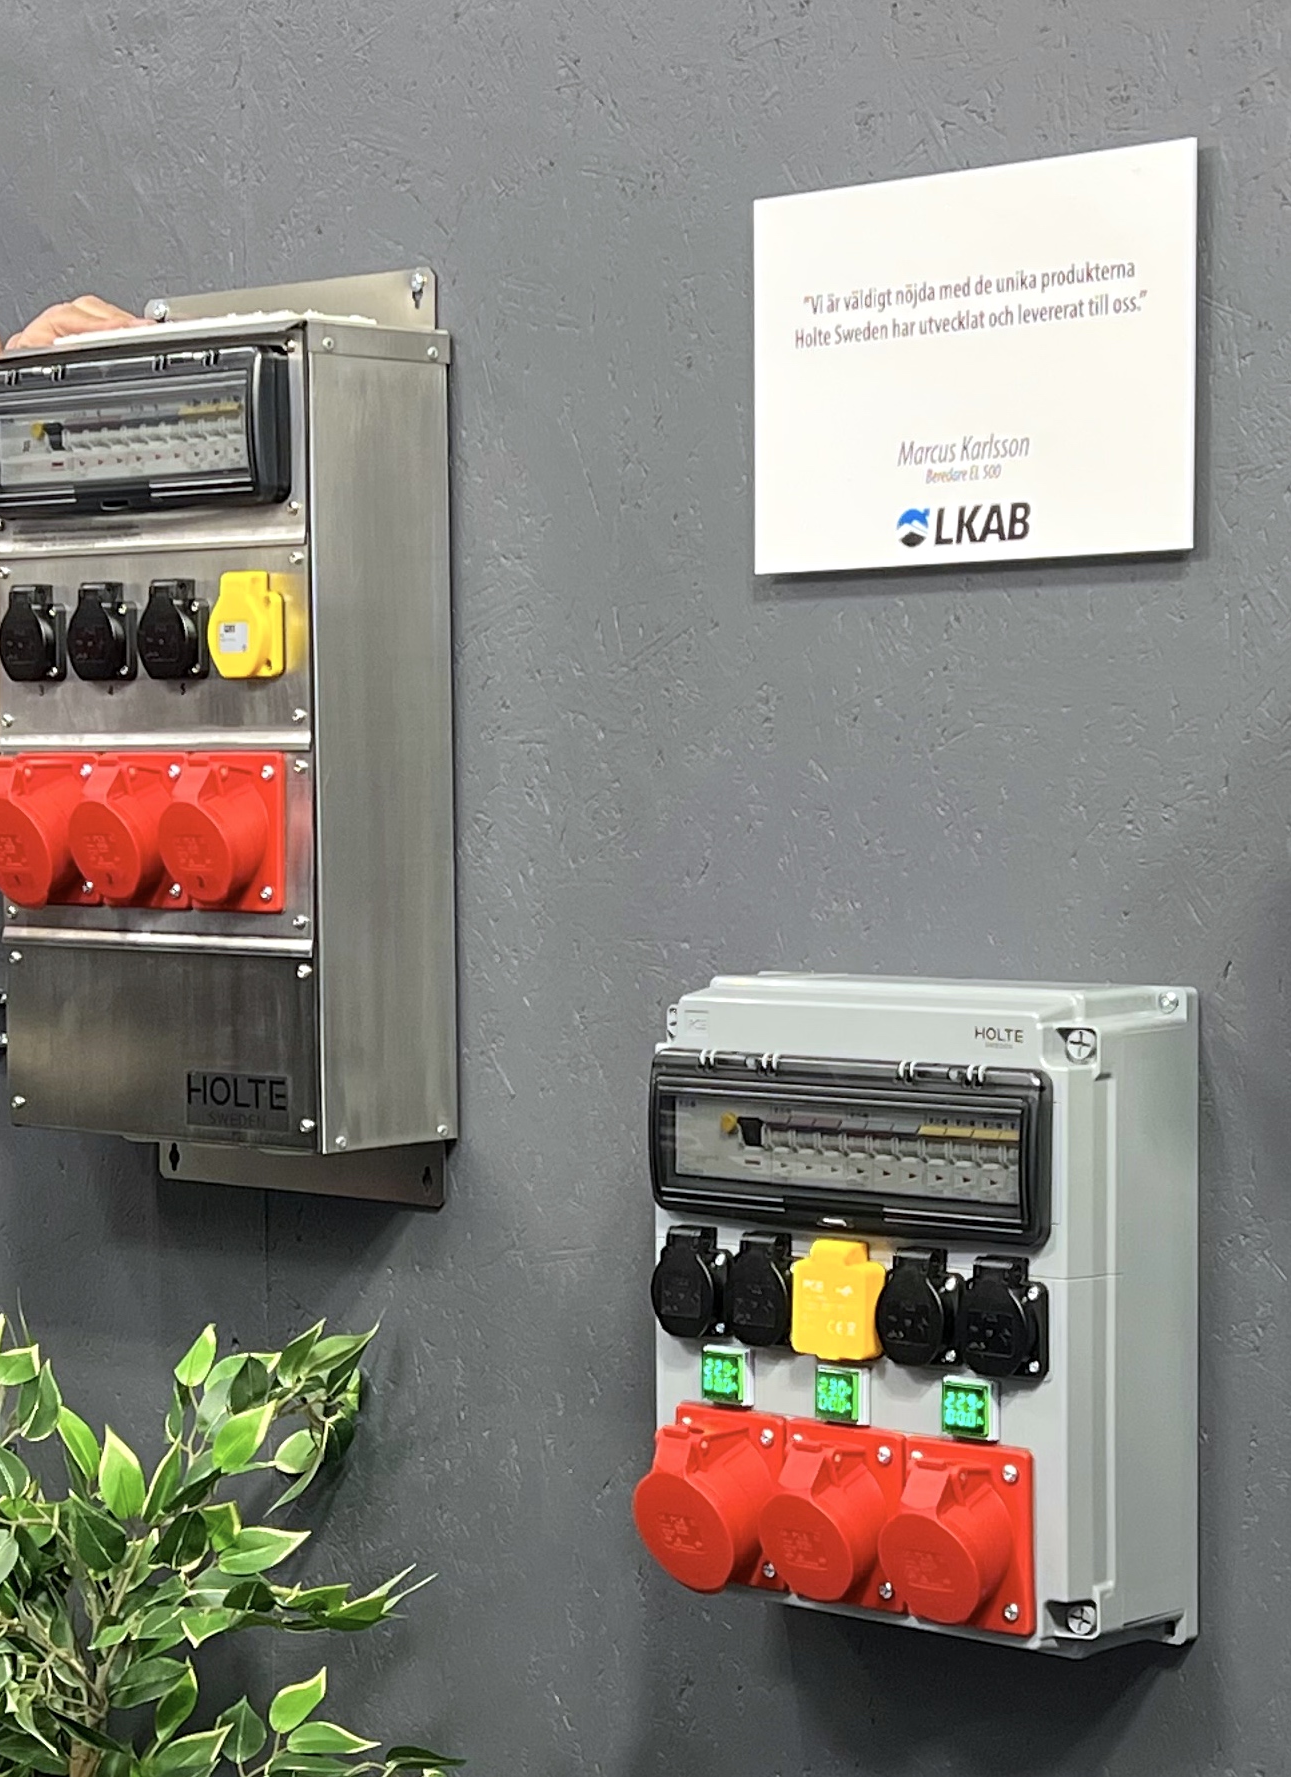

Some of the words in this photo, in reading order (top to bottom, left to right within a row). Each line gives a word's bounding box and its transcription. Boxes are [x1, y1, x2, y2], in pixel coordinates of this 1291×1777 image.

[826, 292, 841, 314] är
[843, 287, 893, 313] väldigt
[895, 280, 936, 309] nöjda
[939, 276, 971, 301] med
[974, 274, 993, 296] de
[996, 270, 1037, 293] unika
[1041, 261, 1136, 293] produkterna
[794, 326, 831, 349] Holte
[834, 320, 889, 345] Sweden
[892, 317, 916, 339] har
[919, 308, 985, 336] utvecklat
[988, 304, 1014, 328] och
[1017, 298, 1085, 325] levererat
[1088, 293, 1109, 317] till
[897, 440, 957, 467] Marcus
[960, 433, 1031, 462] Karlsson
[934, 501, 1031, 546] LKAB
[974, 1026, 1024, 1043] HOLTE
[187, 1073, 287, 1111] HOLTE
[208, 1111, 267, 1128] SWEDEN
